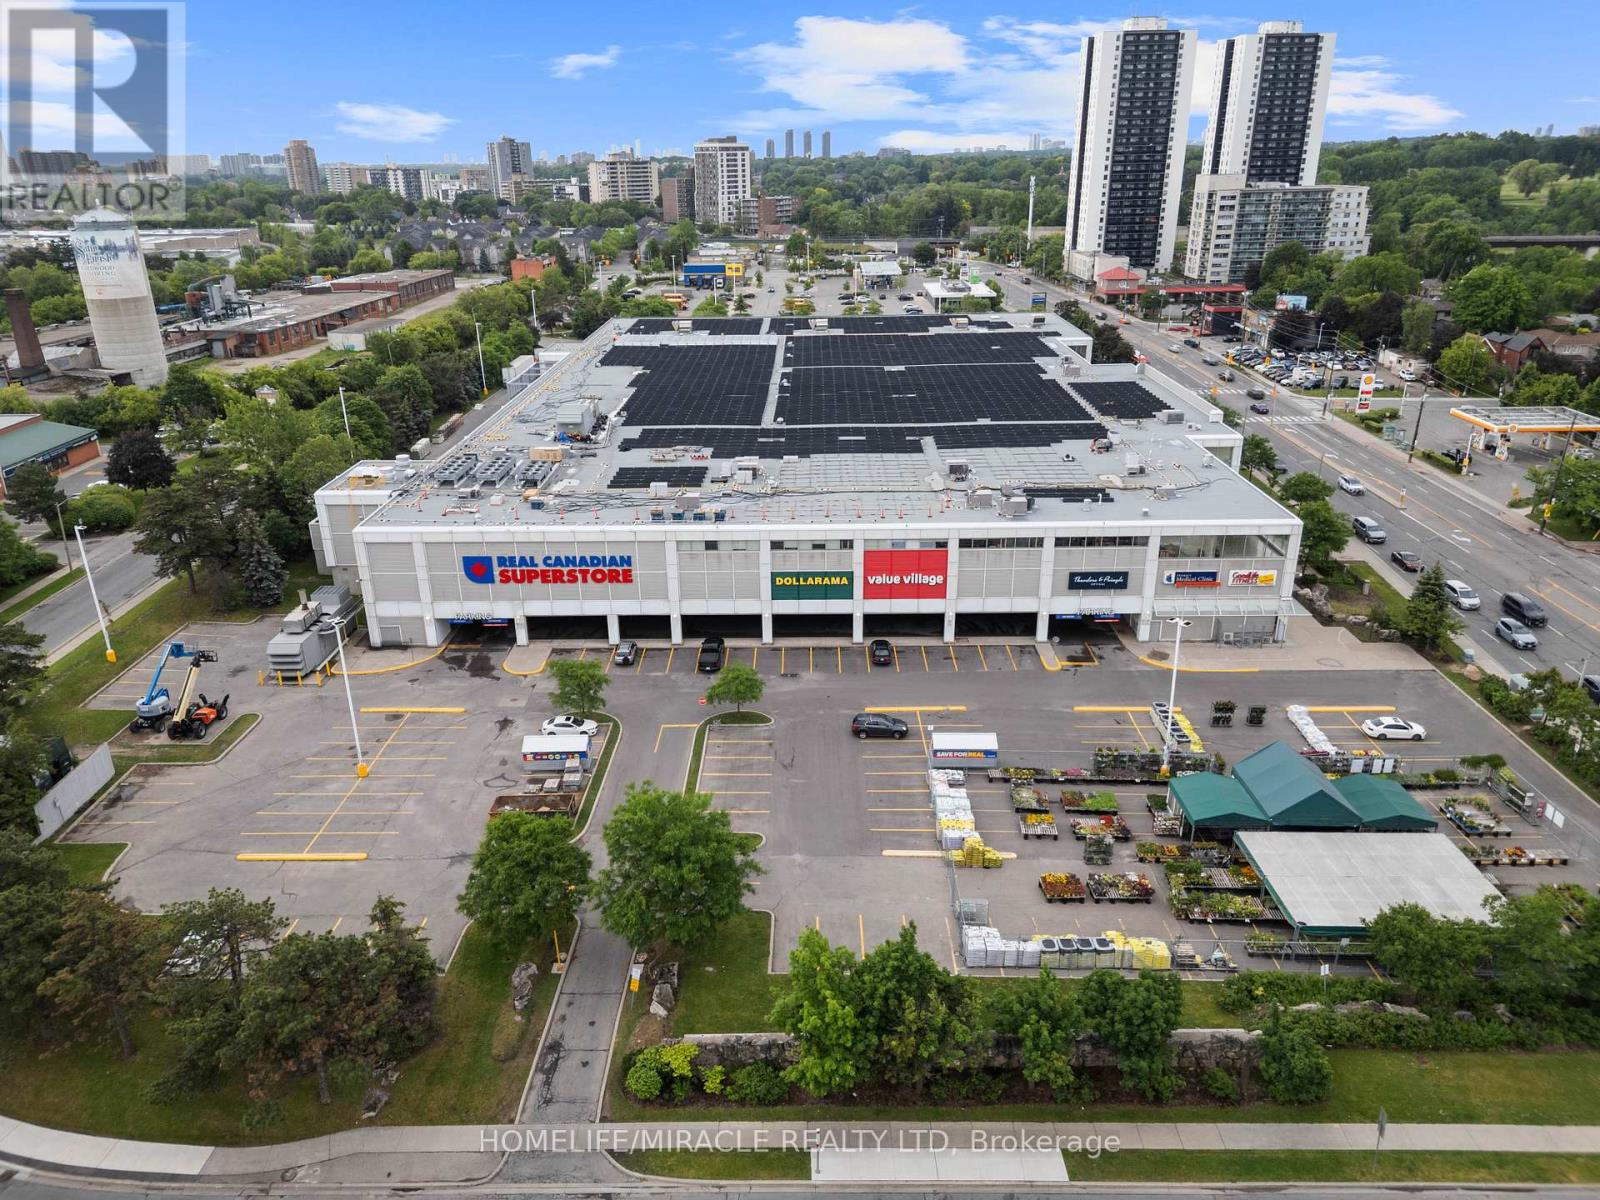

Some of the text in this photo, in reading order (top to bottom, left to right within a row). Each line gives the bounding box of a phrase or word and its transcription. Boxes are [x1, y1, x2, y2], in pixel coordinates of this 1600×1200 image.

[496, 555, 632, 568] REAL CANADIAN
[499, 568, 634, 585] SUPERSTORE
[775, 576, 849, 586] DOLLARAMA
[867, 573, 944, 586] value village
[455, 612, 493, 621] PARKING
